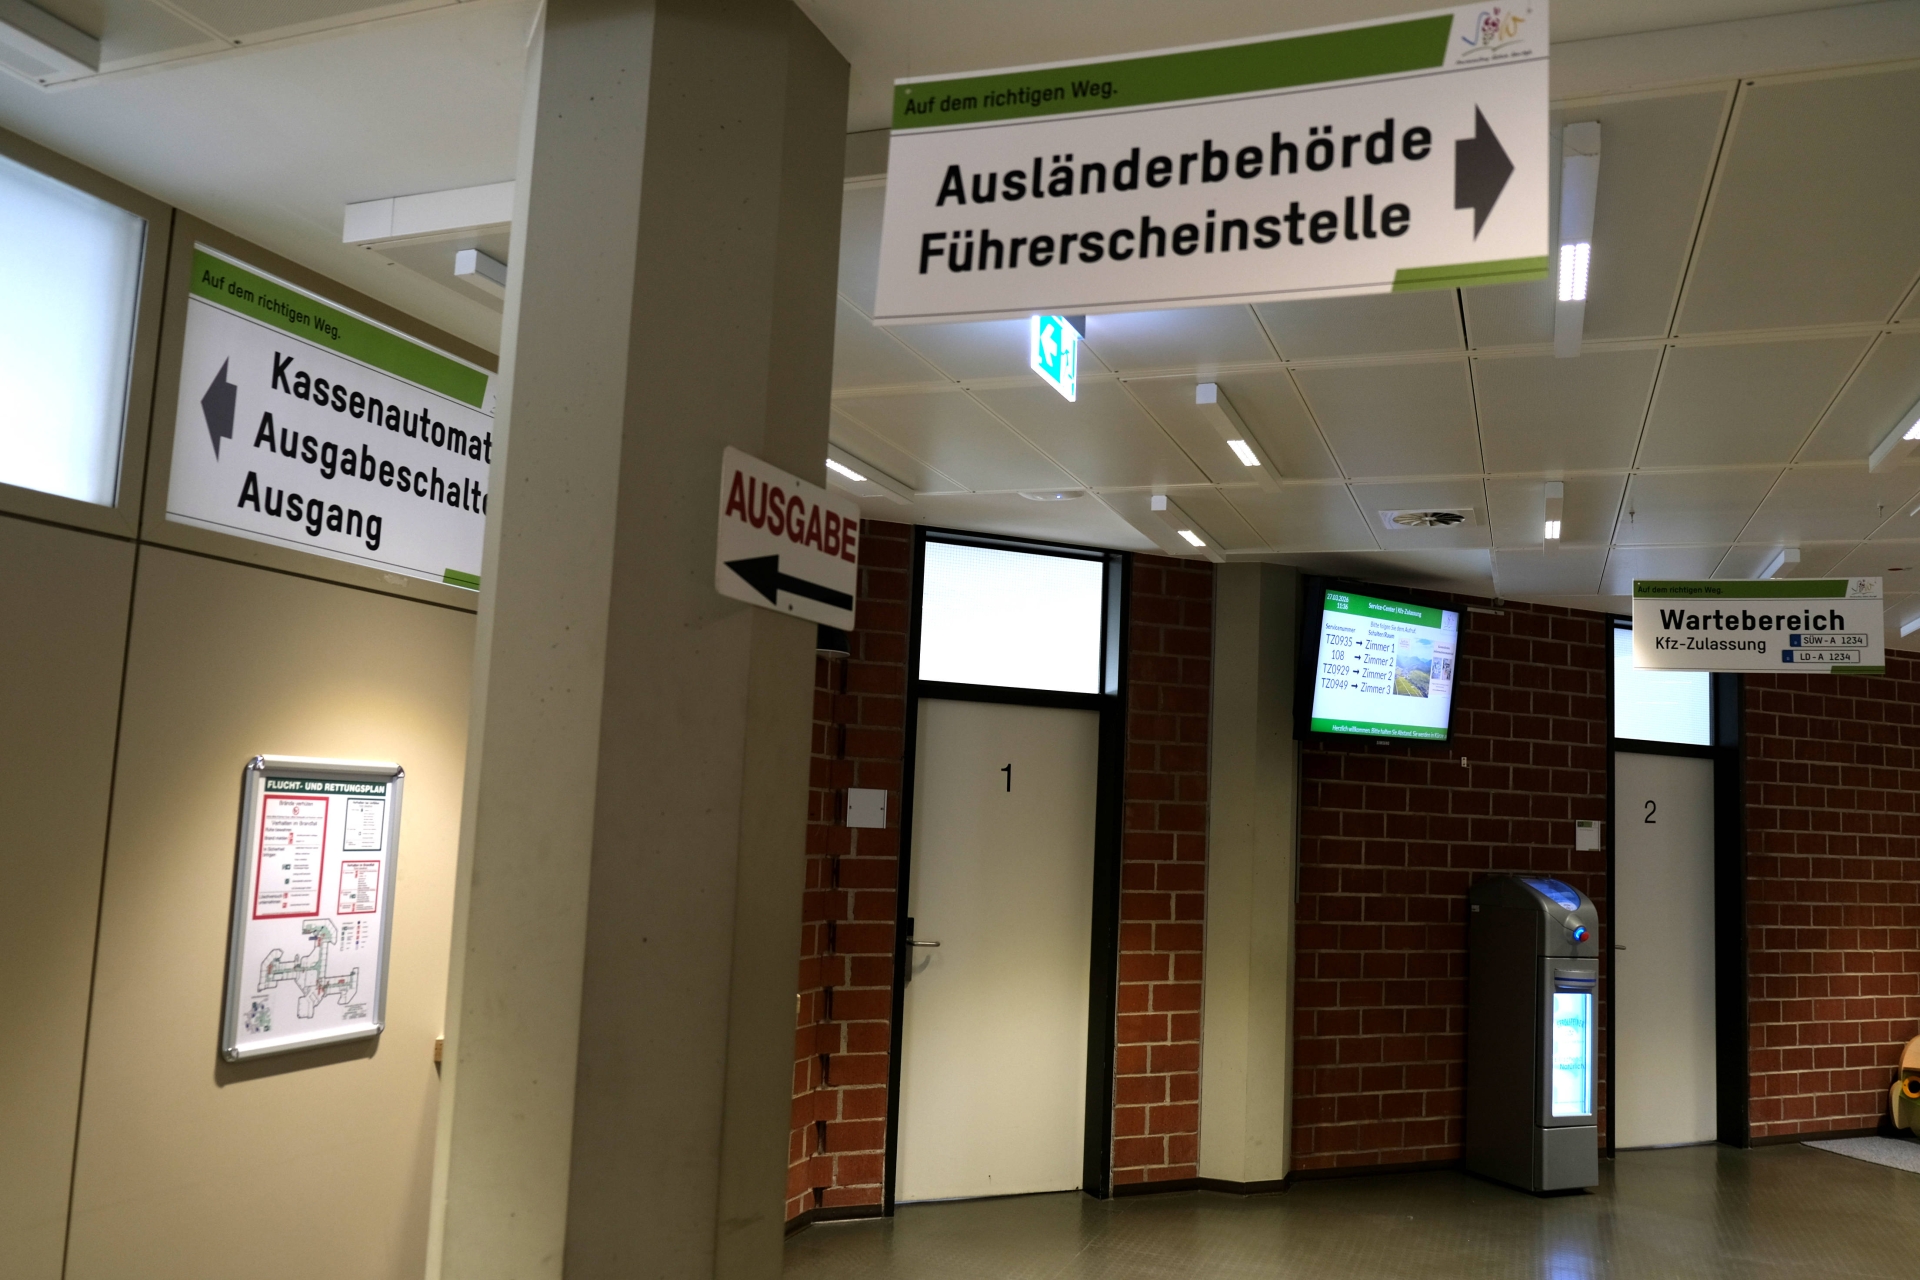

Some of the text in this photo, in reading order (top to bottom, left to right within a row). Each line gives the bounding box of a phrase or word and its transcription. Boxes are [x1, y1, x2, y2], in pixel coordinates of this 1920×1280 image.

[904, 79, 1118, 116] Auf dem richtigen Weg.
[935, 117, 1433, 208] Ausländerbehörde
[918, 193, 1411, 275] Führerscheinstelle
[201, 270, 341, 340] Auf dem richtigen Weg.
[271, 351, 492, 465] Kassenautomat
[237, 470, 383, 551] Ausgang
[725, 469, 858, 564] AUSGABE
[1669, 586, 1702, 595] richtigen
[1704, 586, 1723, 595] Weg.
[1660, 609, 1845, 631] Wartebereich
[1326, 633, 1353, 647] TZ0935
[1364, 639, 1389, 652] Zimmer
[1391, 643, 1395, 653] 1
[1656, 636, 1767, 654] Kfz-Zulassung
[1841, 636, 1863, 645] 1234
[1331, 649, 1394, 667] 108 Zimmer 2
[1829, 653, 1851, 661] 1234
[1322, 662, 1393, 681] TZ0929 Zimmer 2
[1321, 677, 1391, 695] TZ0949 Zimmer 3
[266, 780, 386, 794] FLUCHT- UND RETTUNGSPLAN
[1001, 763, 1012, 792] 1
[1644, 799, 1657, 824] 2
